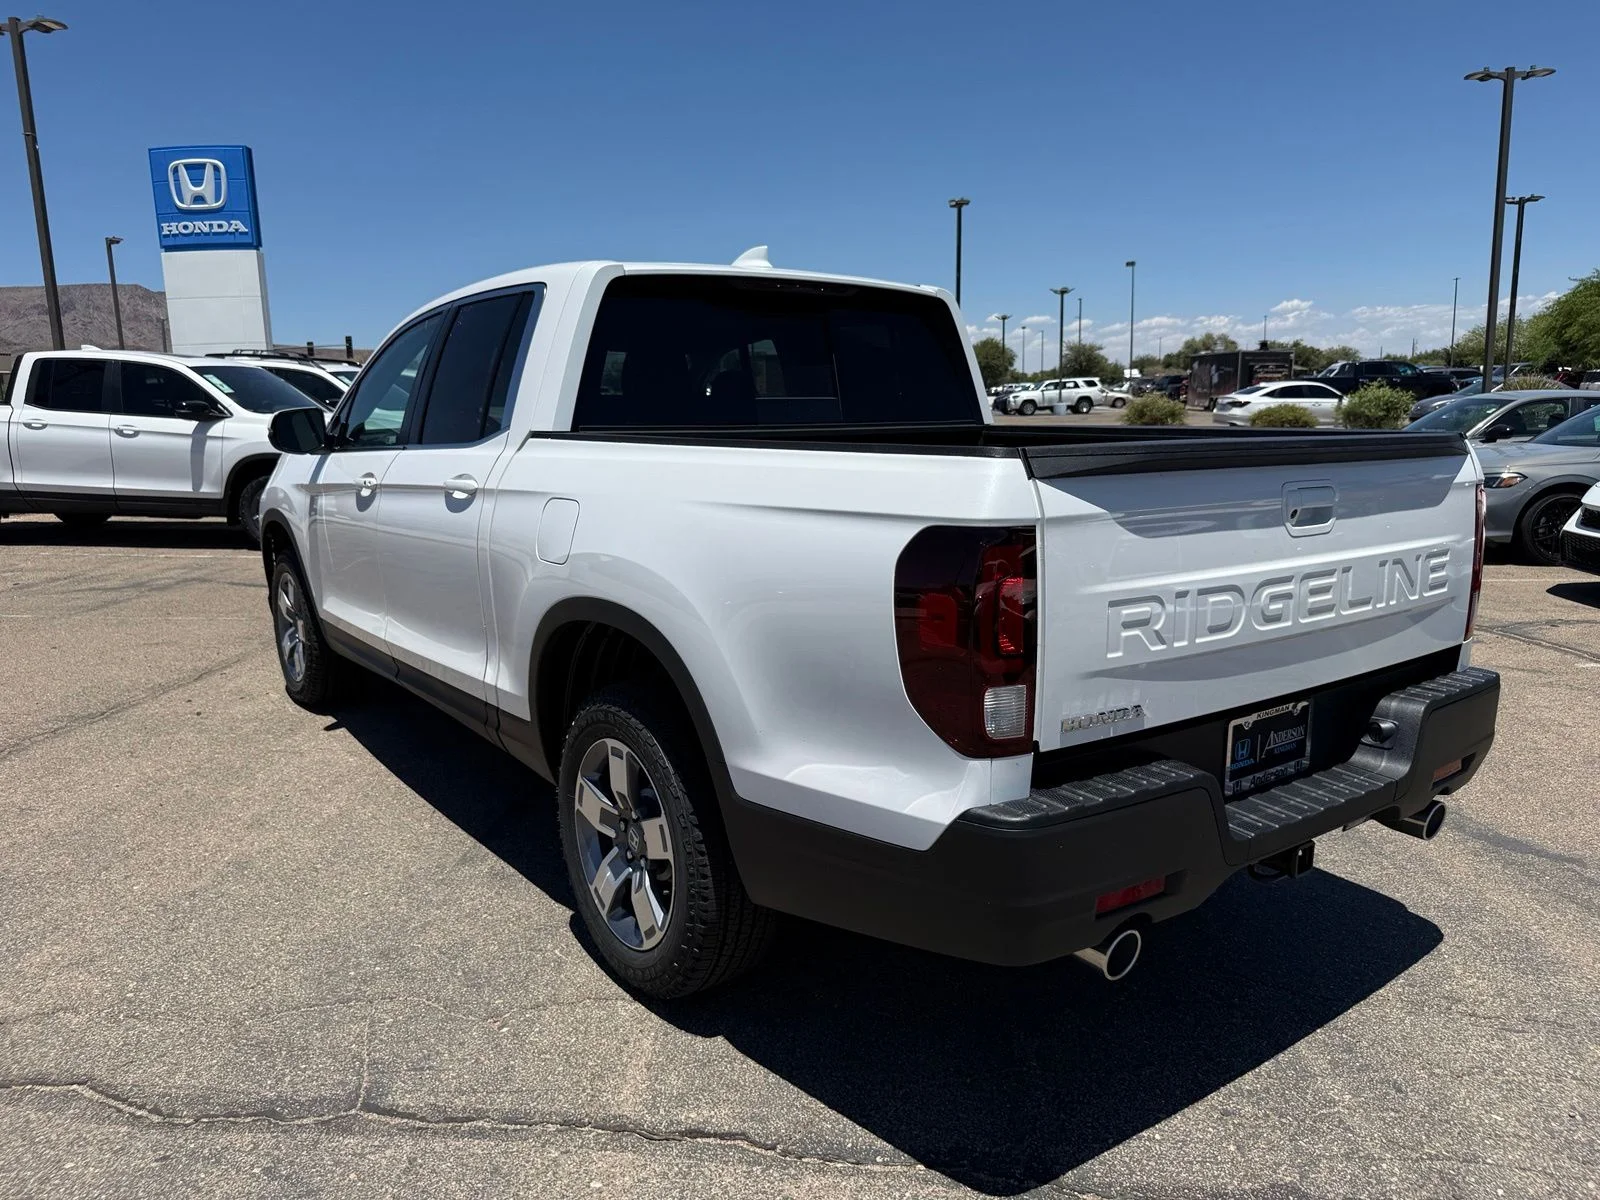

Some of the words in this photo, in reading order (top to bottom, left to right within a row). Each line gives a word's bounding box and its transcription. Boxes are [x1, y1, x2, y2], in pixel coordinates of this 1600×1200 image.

[161, 220, 249, 235] HONDA
[1106, 548, 1450, 658] RIDGELINE
[1060, 704, 1146, 733] HONDA
[1257, 705, 1290, 719] KINGMAN
